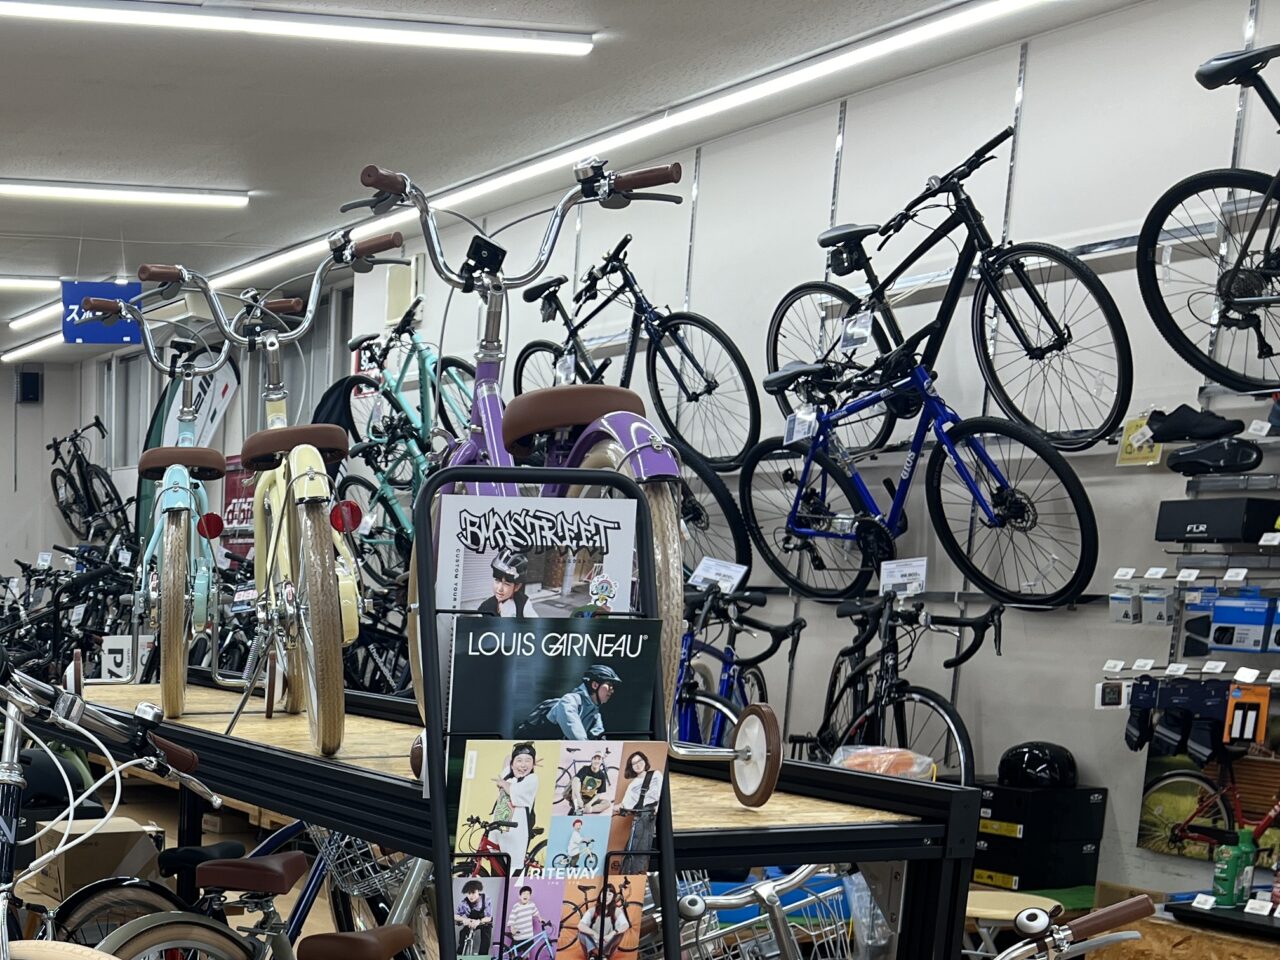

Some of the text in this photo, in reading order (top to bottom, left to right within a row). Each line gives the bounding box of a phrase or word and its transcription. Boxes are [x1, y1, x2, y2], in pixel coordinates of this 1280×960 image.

[468, 631, 644, 658] LOUIS GARNEAU
[529, 867, 600, 880] RITEWAY
